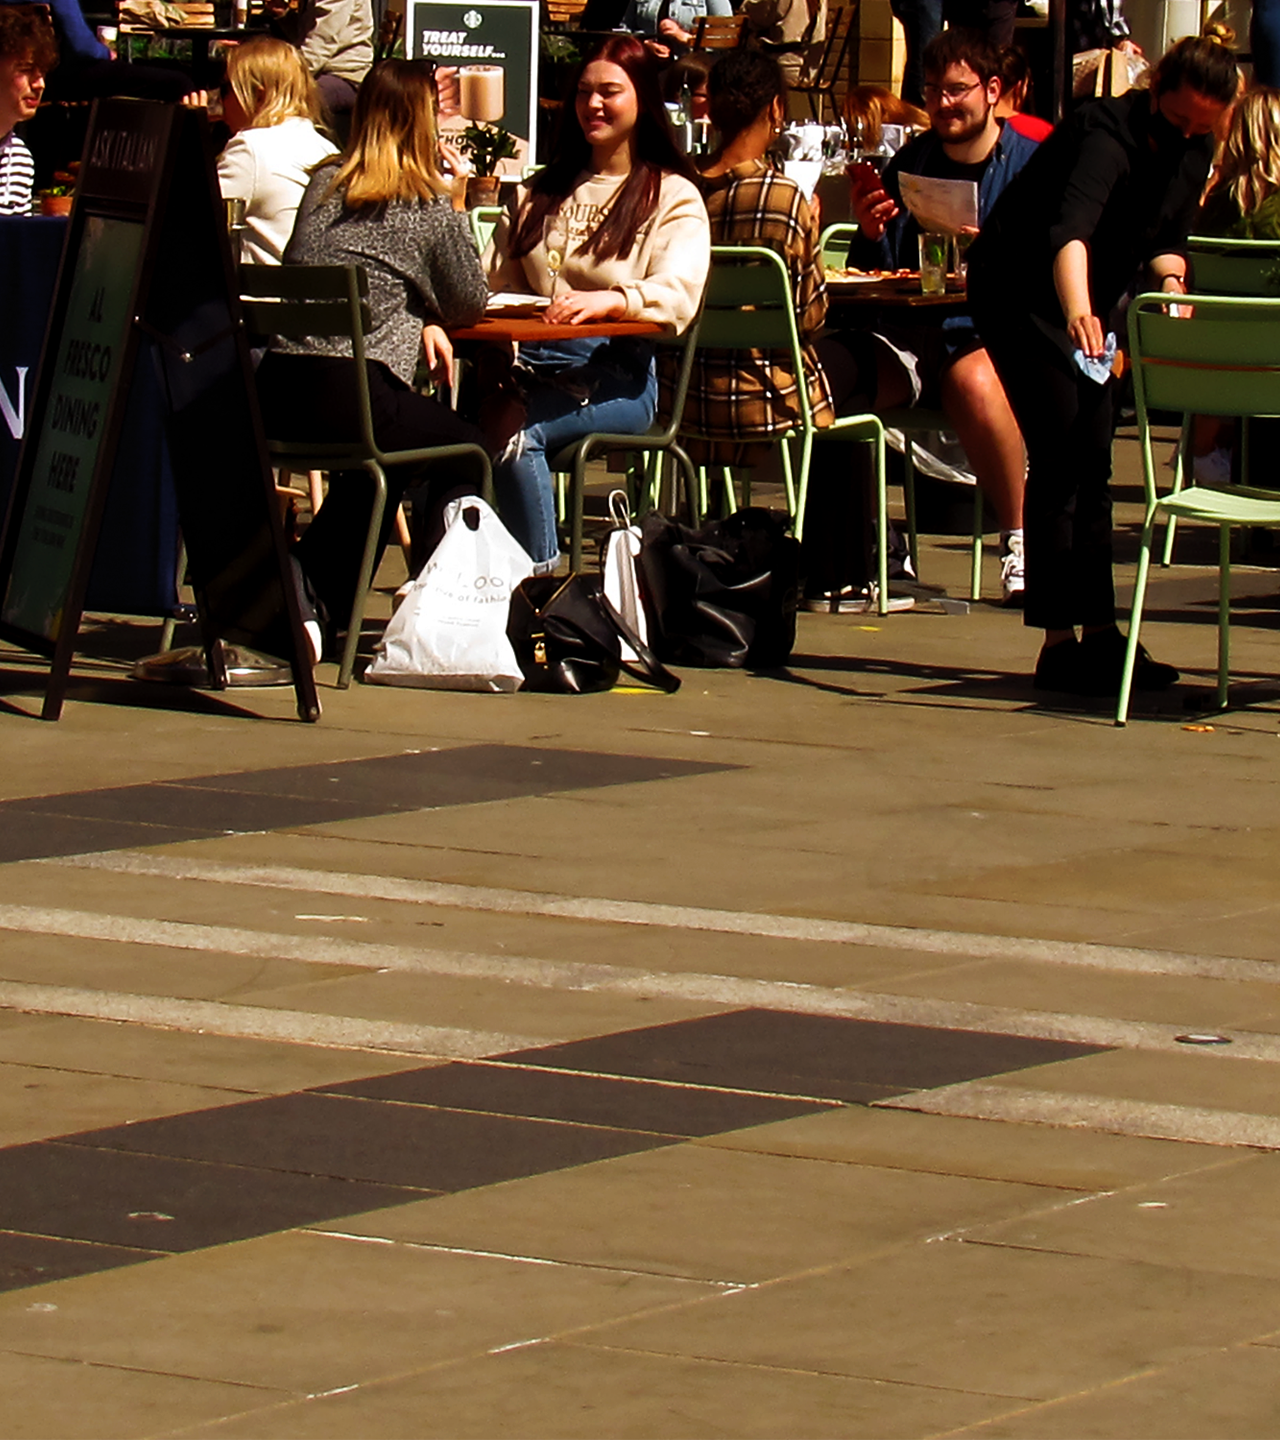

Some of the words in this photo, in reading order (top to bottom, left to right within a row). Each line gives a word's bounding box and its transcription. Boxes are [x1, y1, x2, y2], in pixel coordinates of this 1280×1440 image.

[422, 30, 468, 45] TREAT
[87, 286, 104, 324] AL
[63, 337, 112, 383] FRESCO
[50, 394, 100, 440] DINING
[46, 450, 81, 493] HERE
